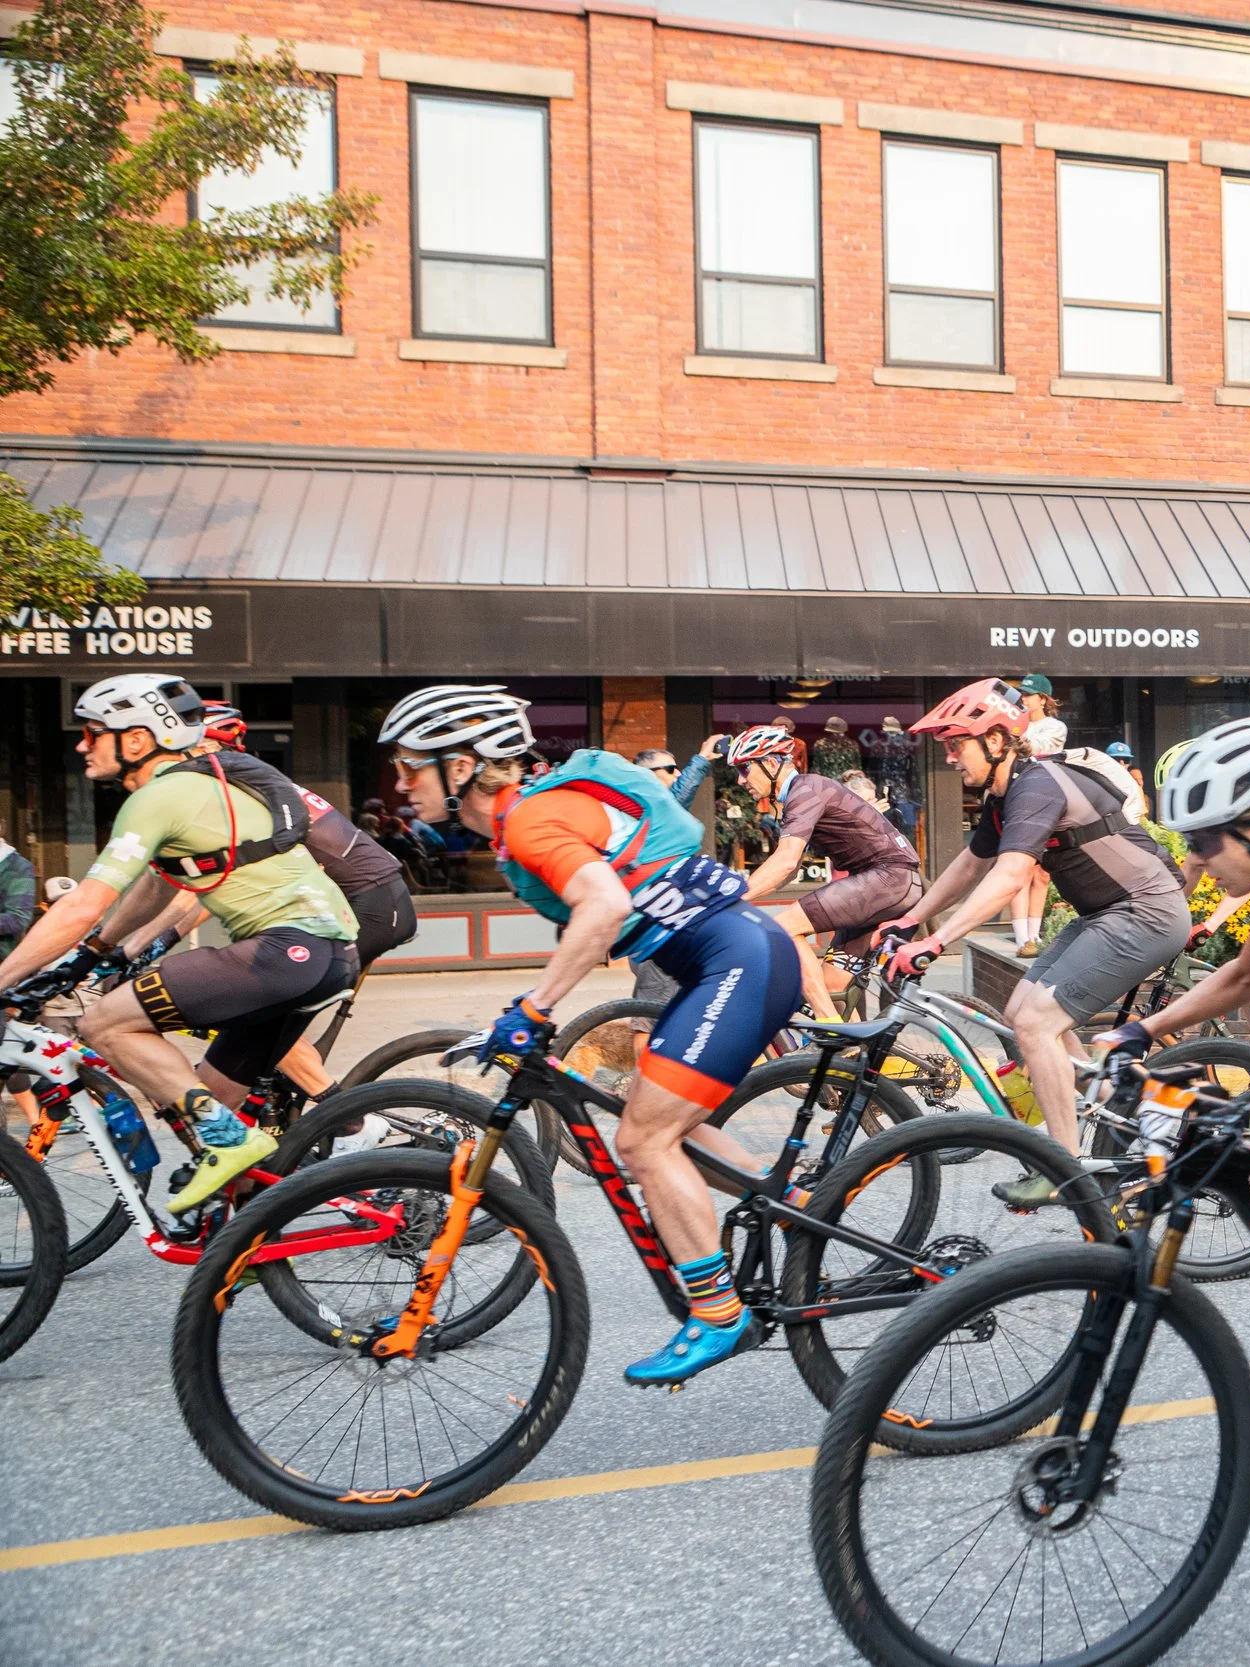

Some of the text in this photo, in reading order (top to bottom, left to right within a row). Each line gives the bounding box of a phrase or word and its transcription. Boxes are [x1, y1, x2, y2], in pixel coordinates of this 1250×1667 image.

[86, 632, 194, 655] HOUSE
[990, 627, 1200, 648] REVY OUTDOORS
[570, 1123, 679, 1285] PIVOT
